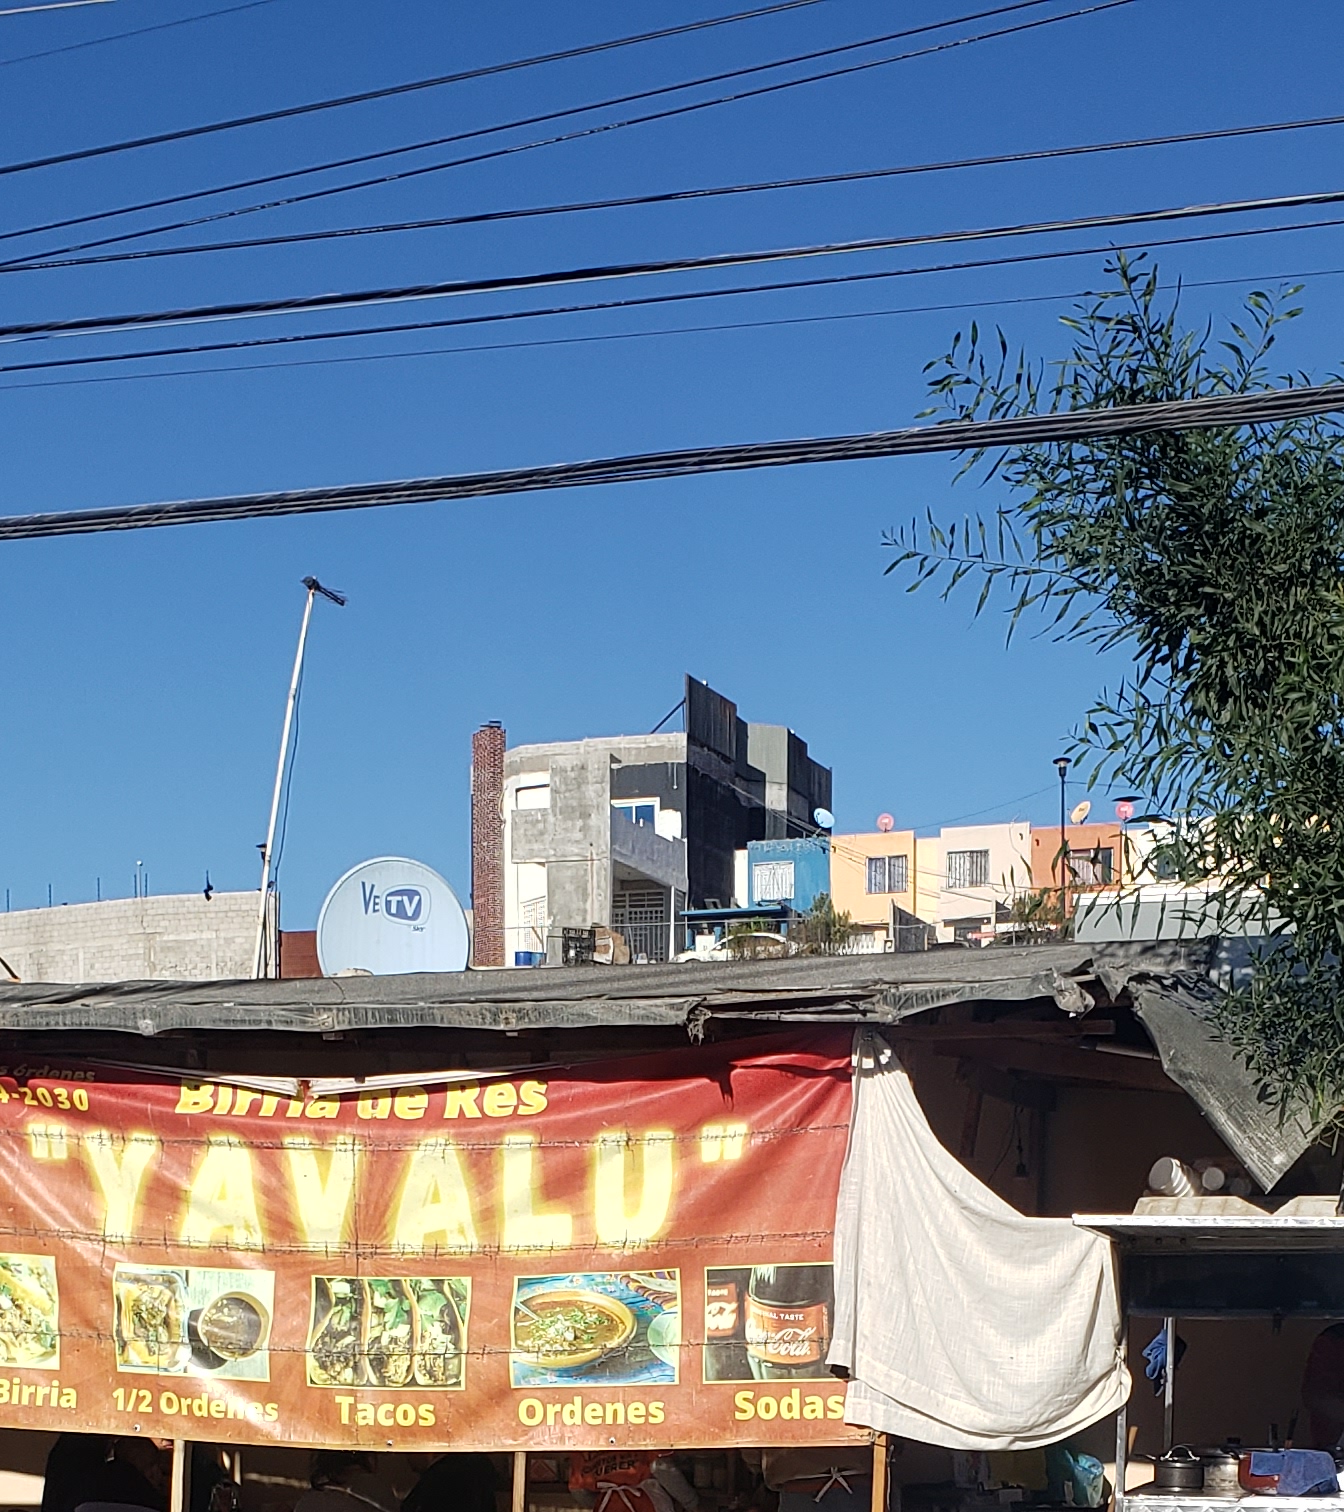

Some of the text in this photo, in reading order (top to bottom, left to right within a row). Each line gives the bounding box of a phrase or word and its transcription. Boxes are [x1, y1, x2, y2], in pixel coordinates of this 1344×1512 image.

[387, 896, 420, 917] TV
[443, 1080, 548, 1120] Res
[780, 1313, 804, 1321] TASTE
[112, 1387, 279, 1422] 1/2 Ordenes
[335, 1395, 436, 1426] Tacos
[518, 1396, 666, 1426] Ordenes
[734, 1388, 845, 1421] Sodas
